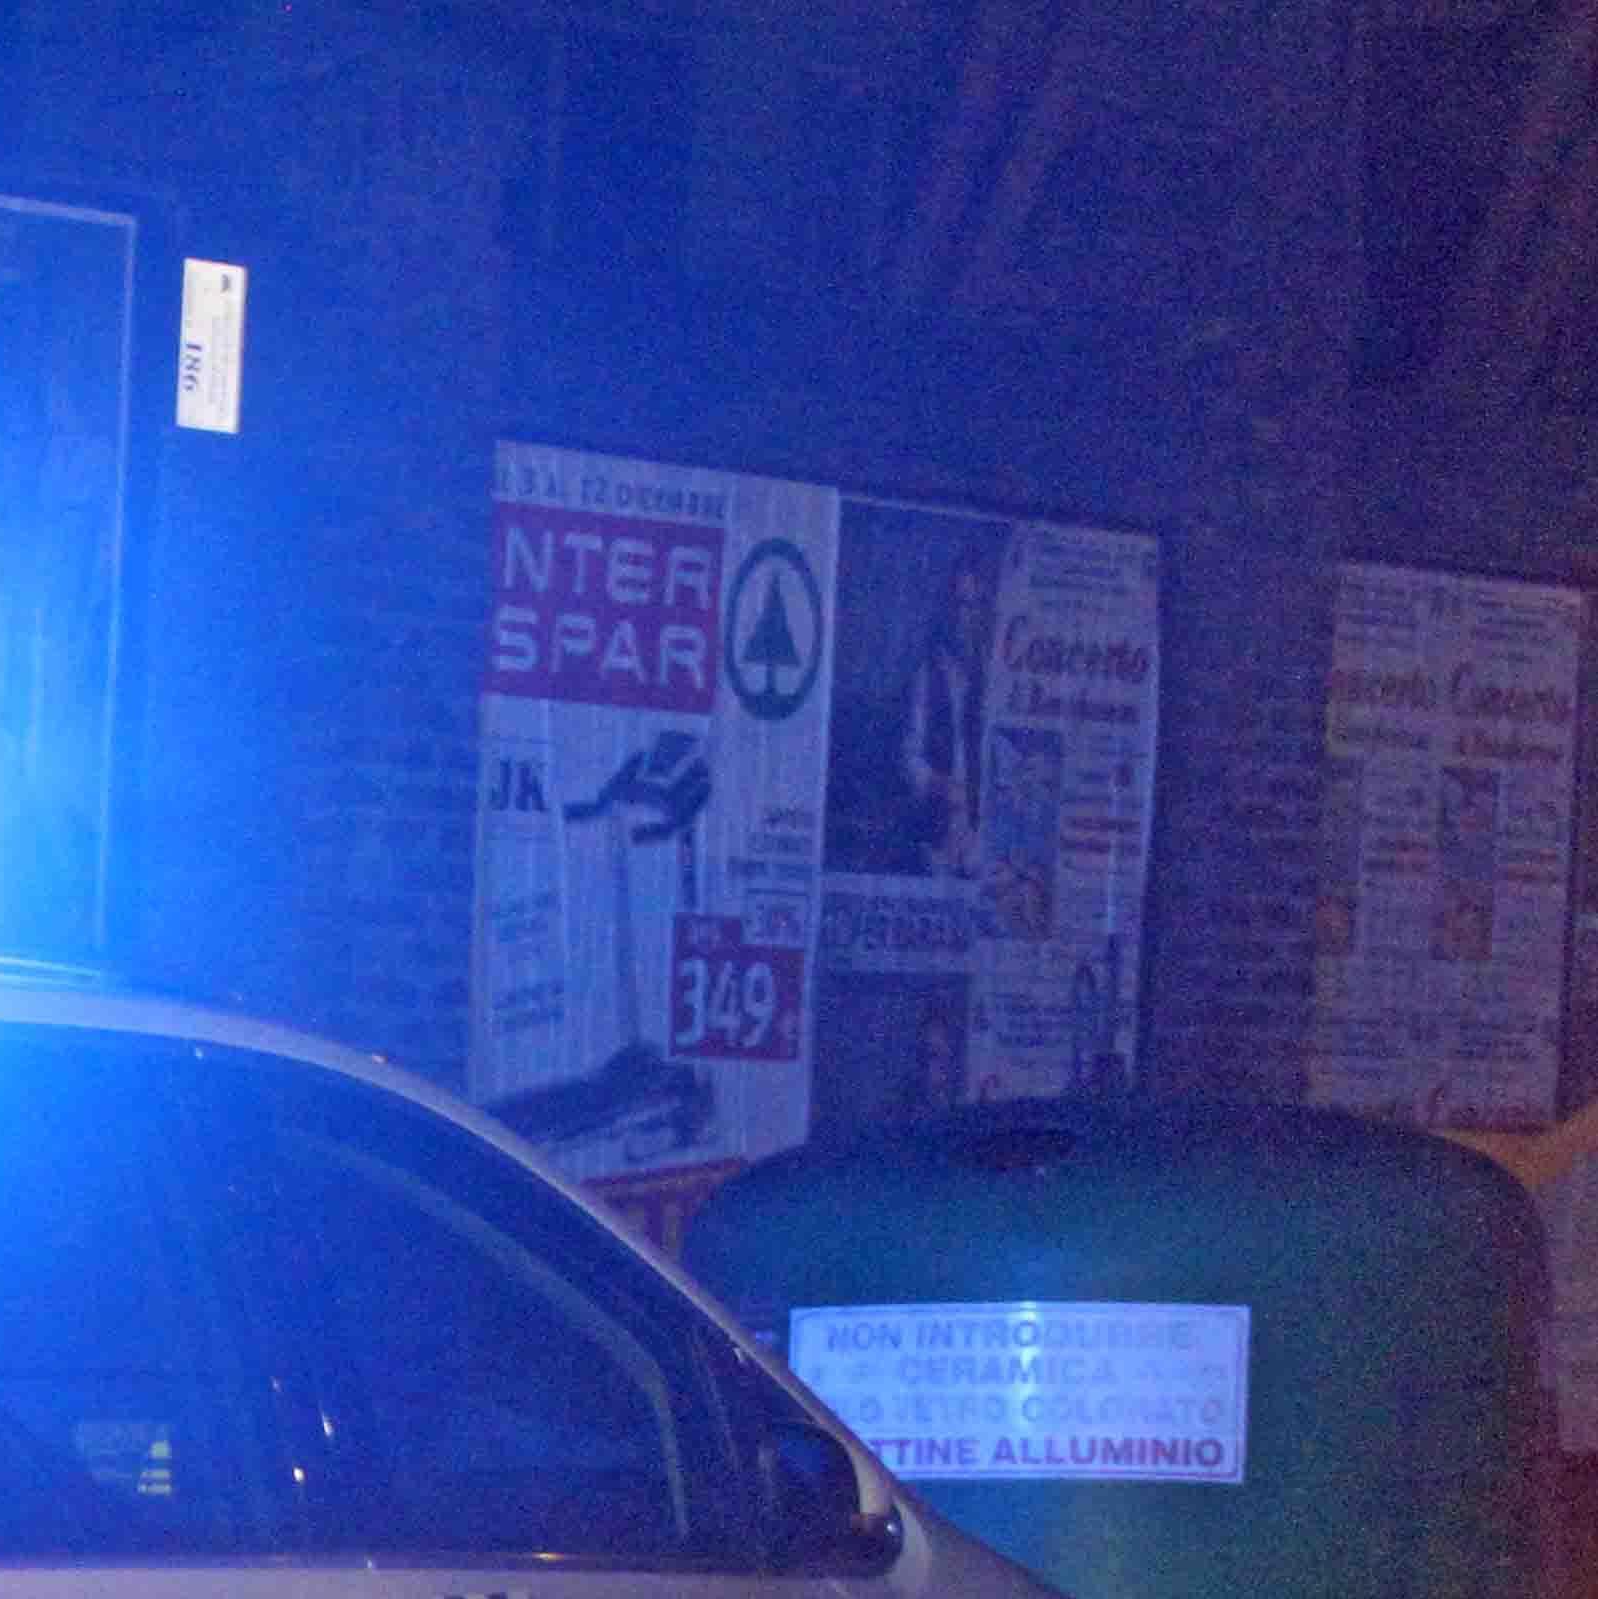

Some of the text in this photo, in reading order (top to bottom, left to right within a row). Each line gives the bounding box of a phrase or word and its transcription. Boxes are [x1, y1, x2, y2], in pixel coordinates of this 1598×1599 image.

[504, 526, 710, 610] NTER
[494, 604, 706, 690] SPAR
[827, 1322, 901, 1352] NON
[871, 1437, 1224, 1468] TTINE ALLUMINIO
